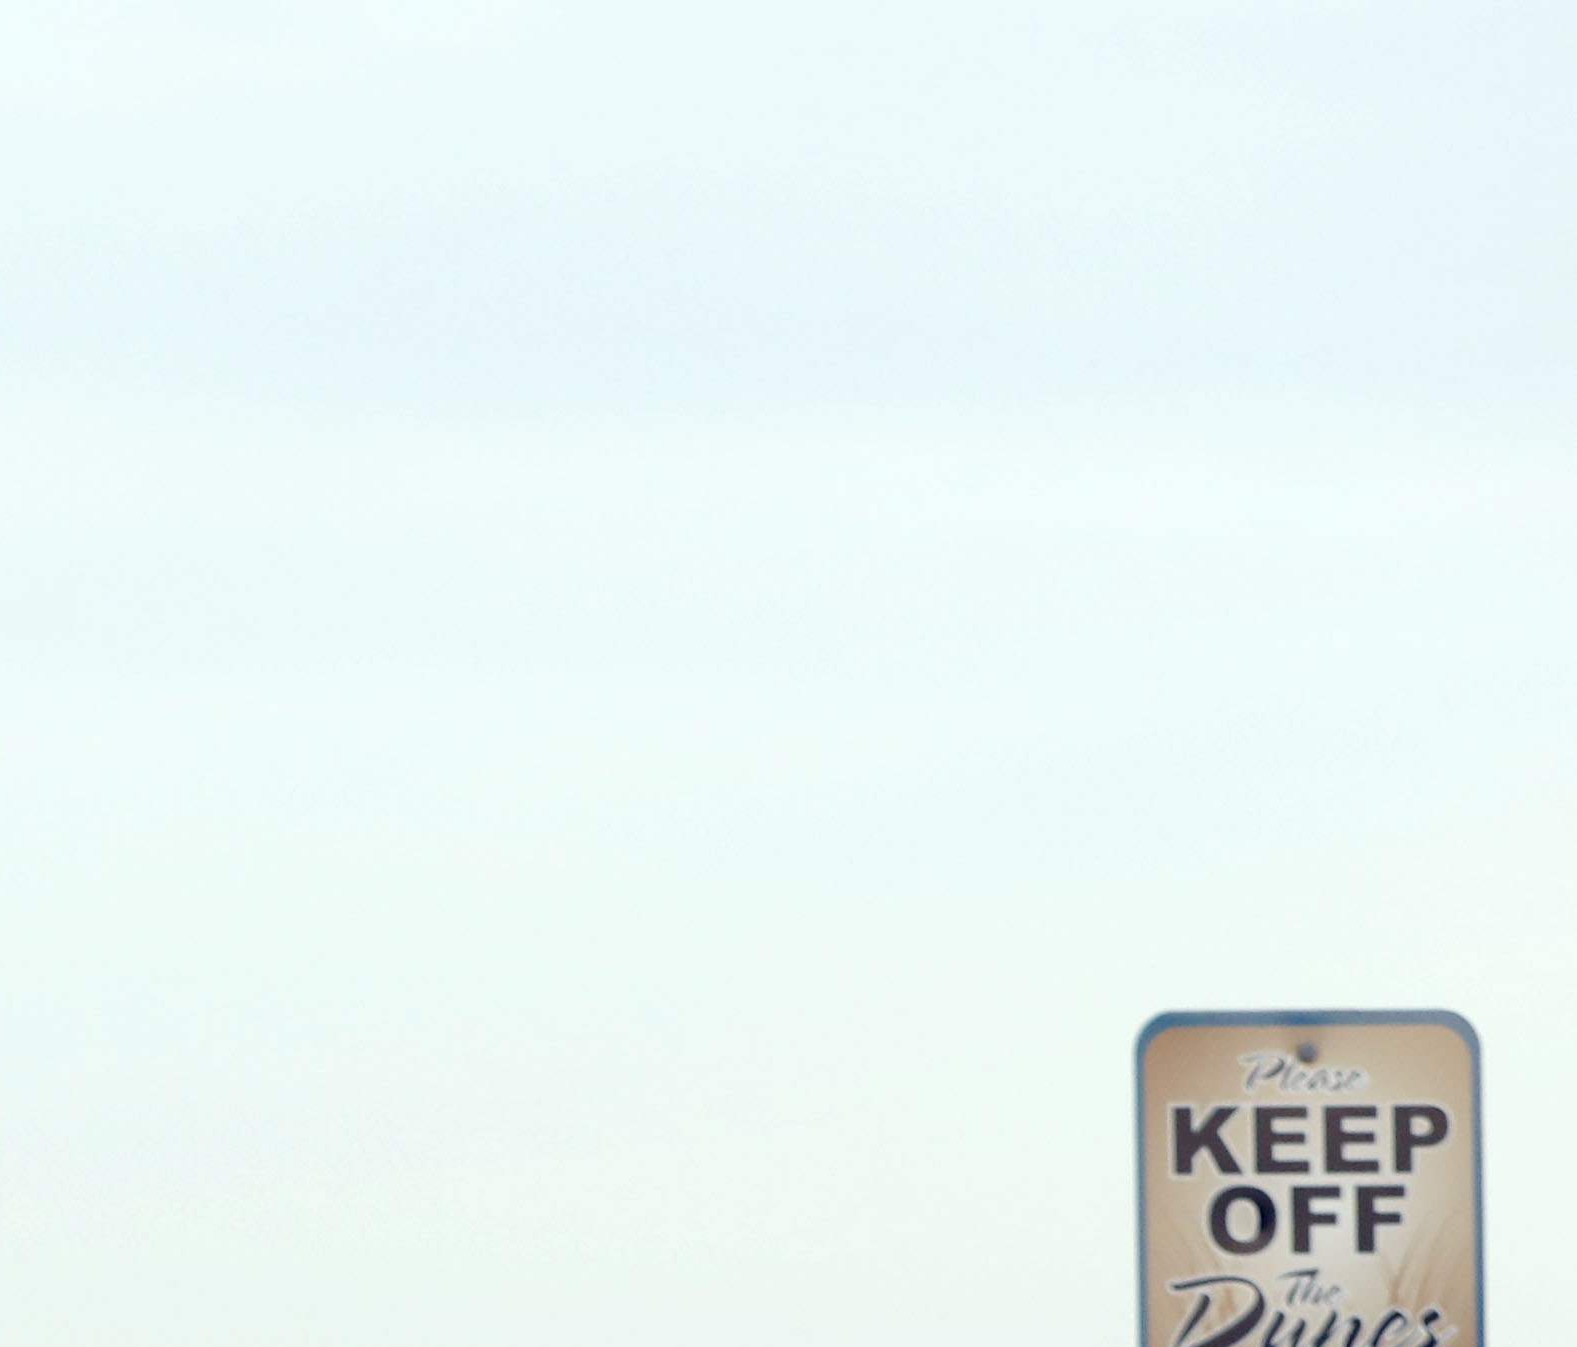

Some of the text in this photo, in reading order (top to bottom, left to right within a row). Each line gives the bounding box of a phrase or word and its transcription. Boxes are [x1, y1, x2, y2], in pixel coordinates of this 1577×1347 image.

[1242, 1053, 1362, 1092] Please
[1173, 1105, 1449, 1175] KEEP
[1209, 1185, 1405, 1255] OFF
[1276, 1267, 1341, 1307] The
